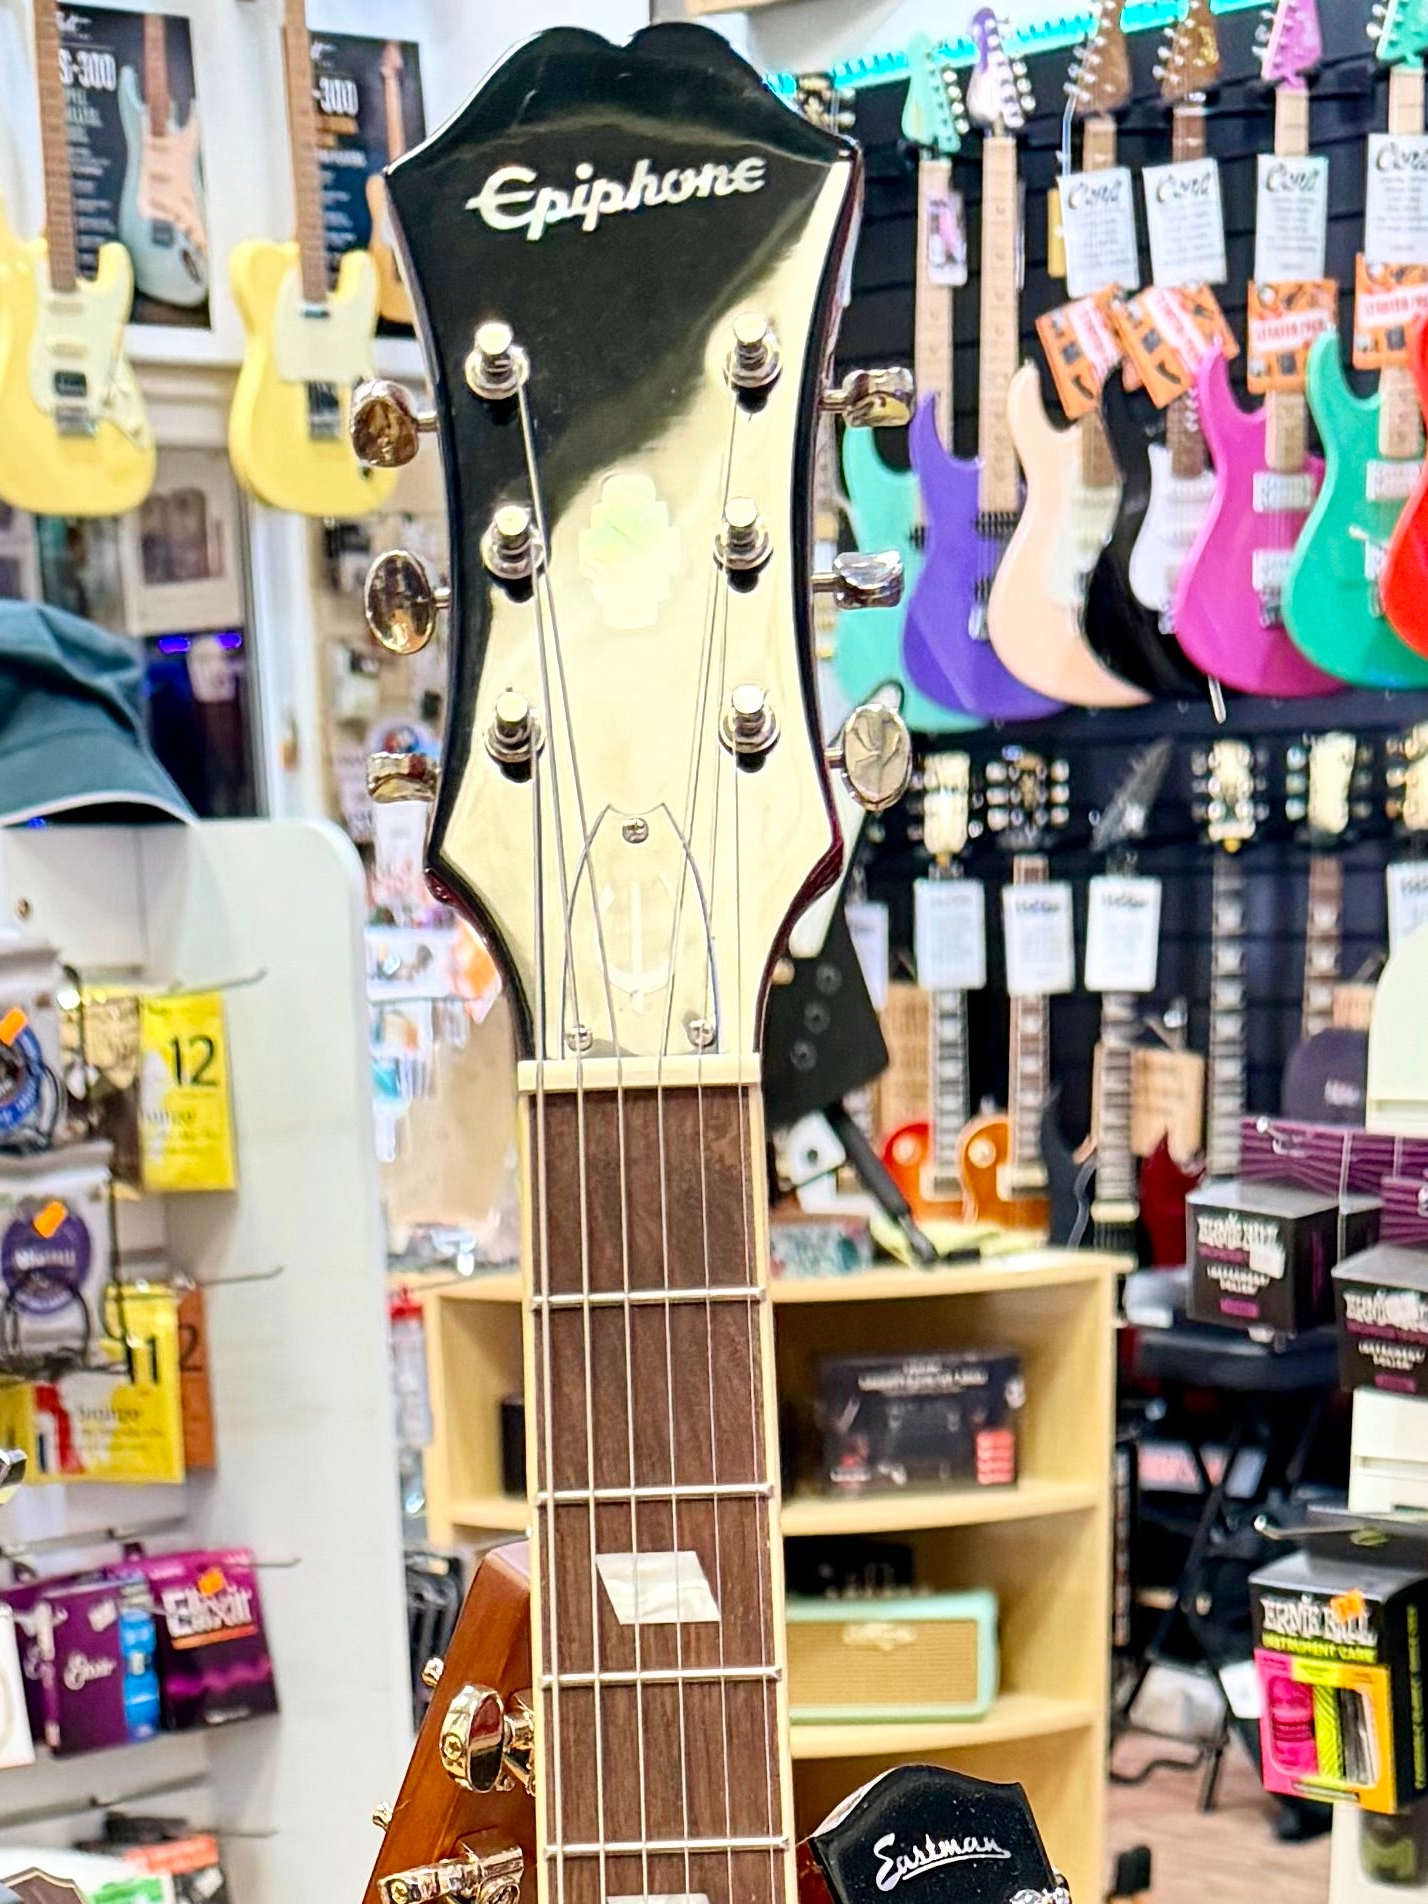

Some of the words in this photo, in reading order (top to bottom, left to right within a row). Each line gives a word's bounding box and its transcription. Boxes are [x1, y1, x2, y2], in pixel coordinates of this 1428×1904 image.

[464, 157, 768, 241] Epiphone
[170, 1032, 217, 1088] 12
[1260, 1592, 1322, 1639] ERNIE
[873, 1832, 1012, 1892] Eastman
